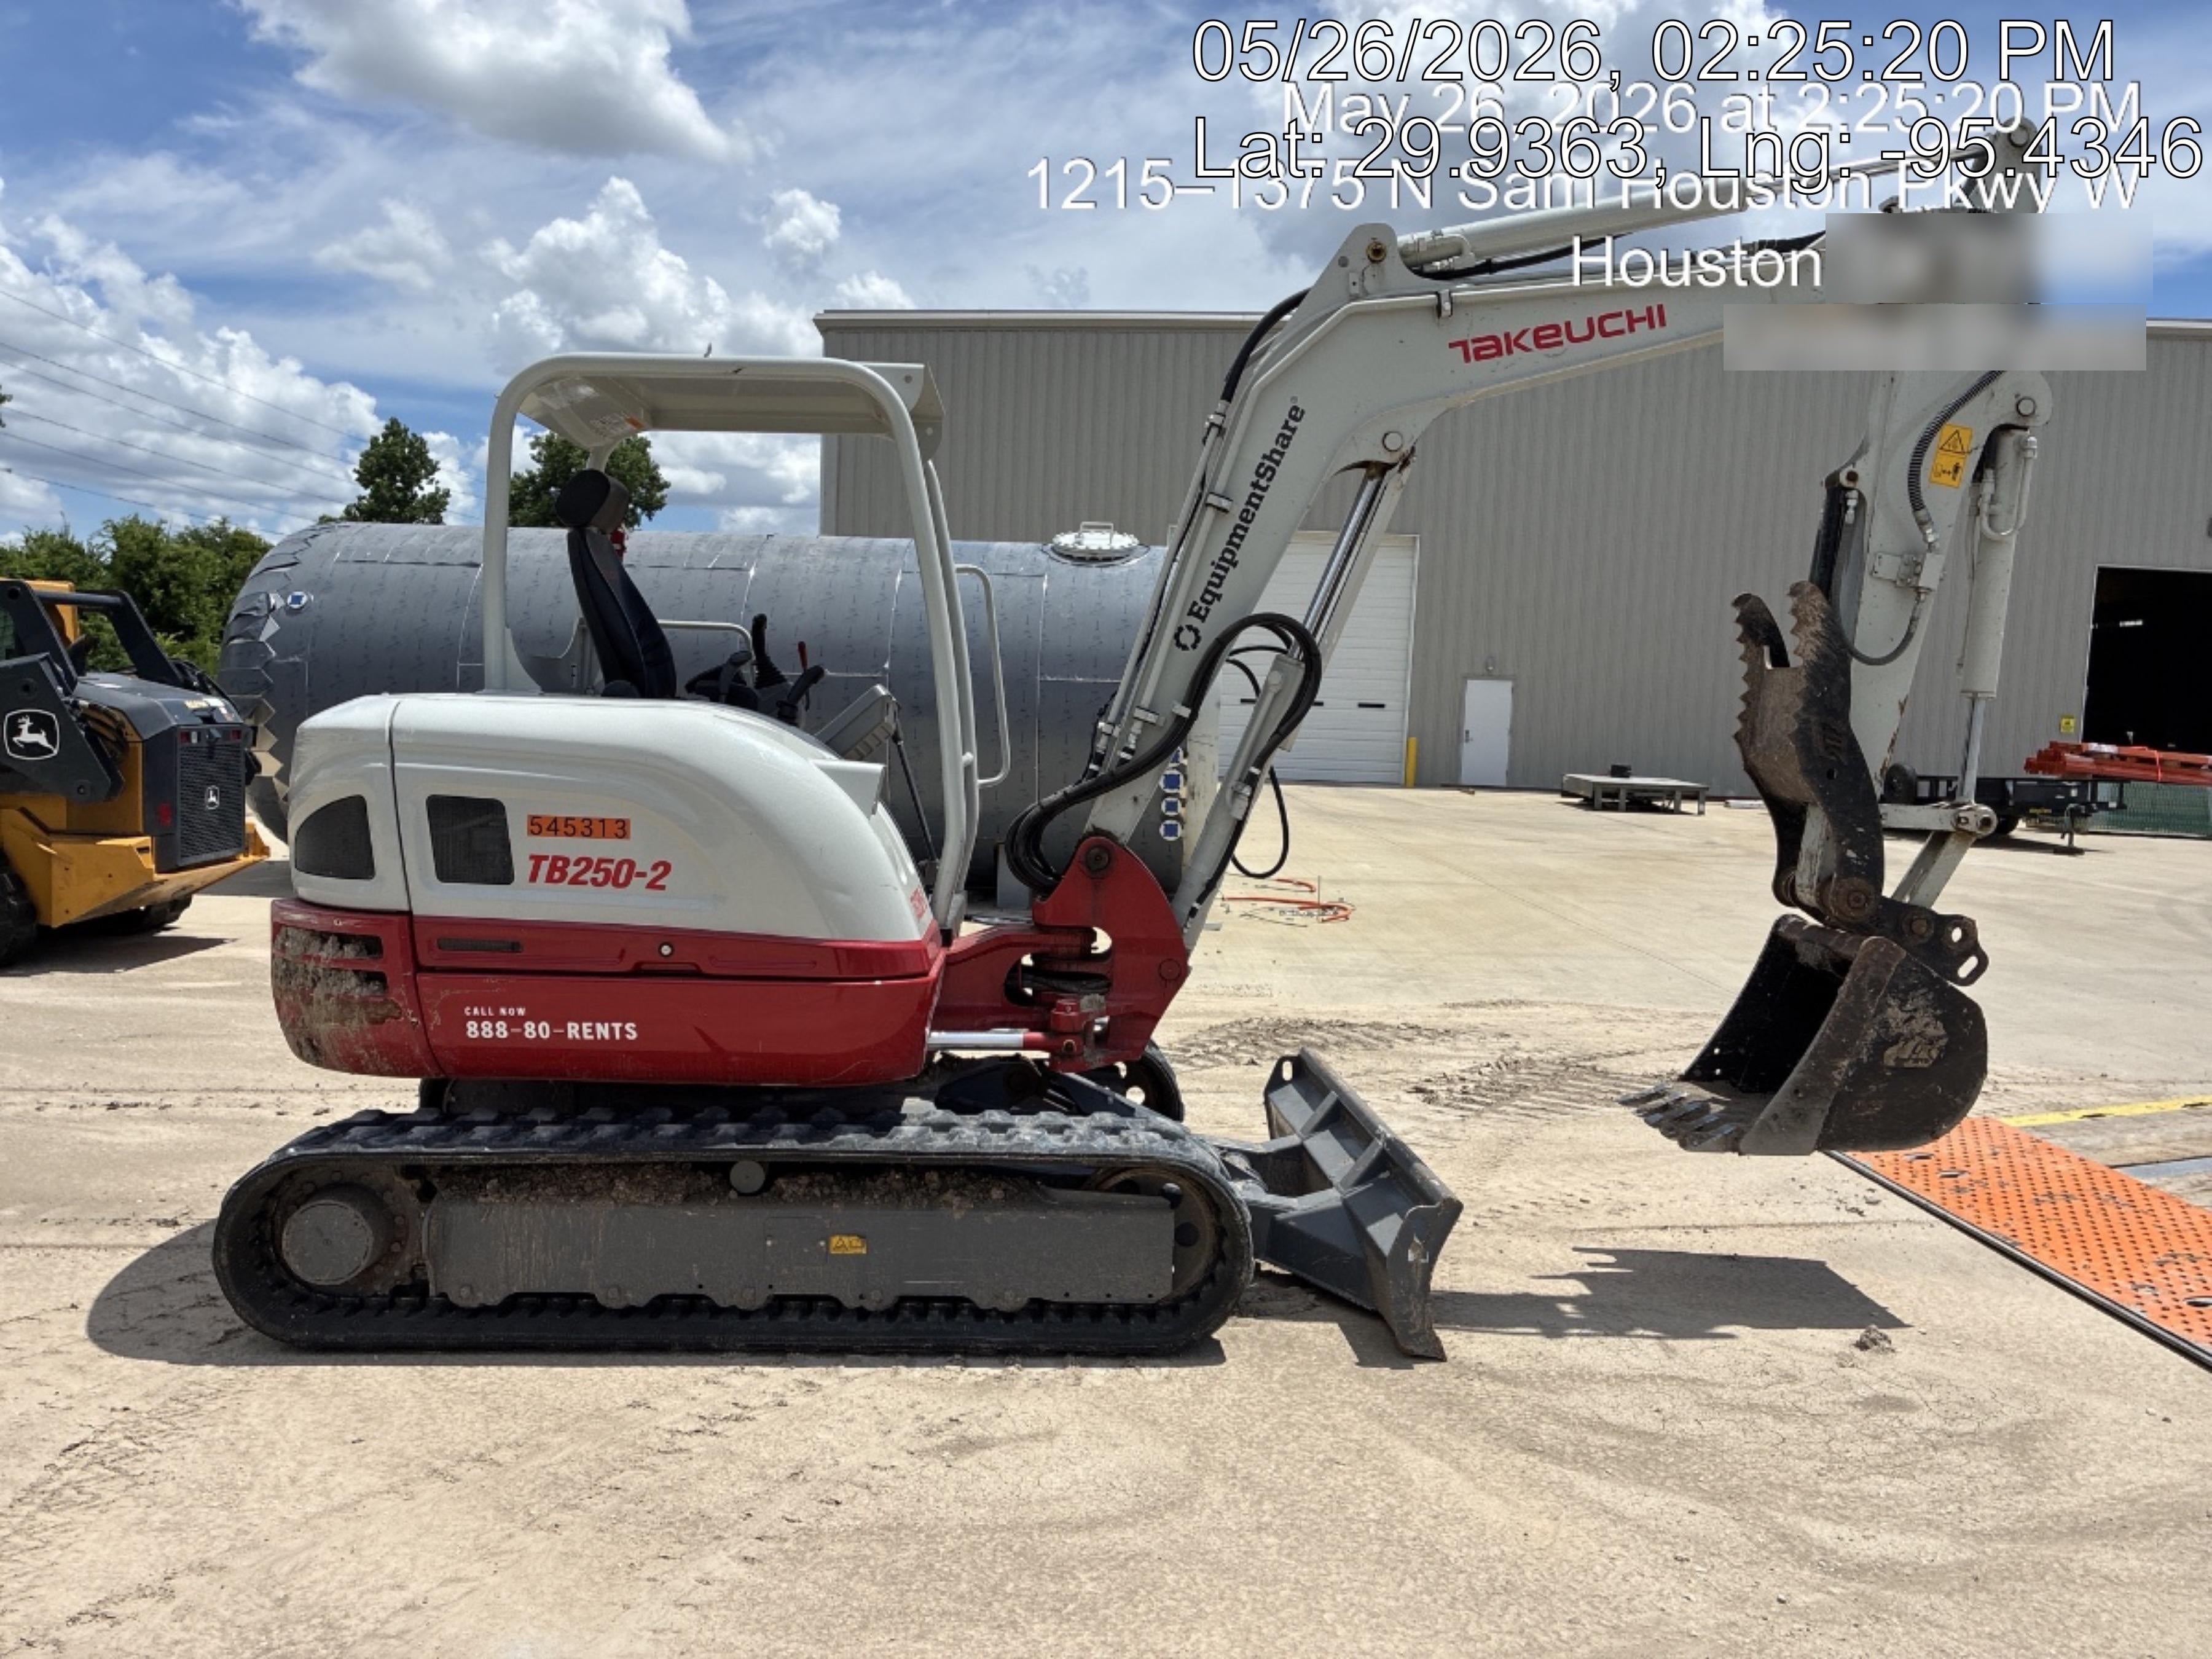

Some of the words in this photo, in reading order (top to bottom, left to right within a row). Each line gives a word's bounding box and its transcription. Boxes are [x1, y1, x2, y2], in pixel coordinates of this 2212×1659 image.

[530, 816, 628, 839] 545313
[528, 853, 672, 891] TB250-2
[464, 1006, 494, 1016] CALL
[500, 1006, 526, 1016] NOW
[466, 1021, 638, 1040] 888-80-RENTS
